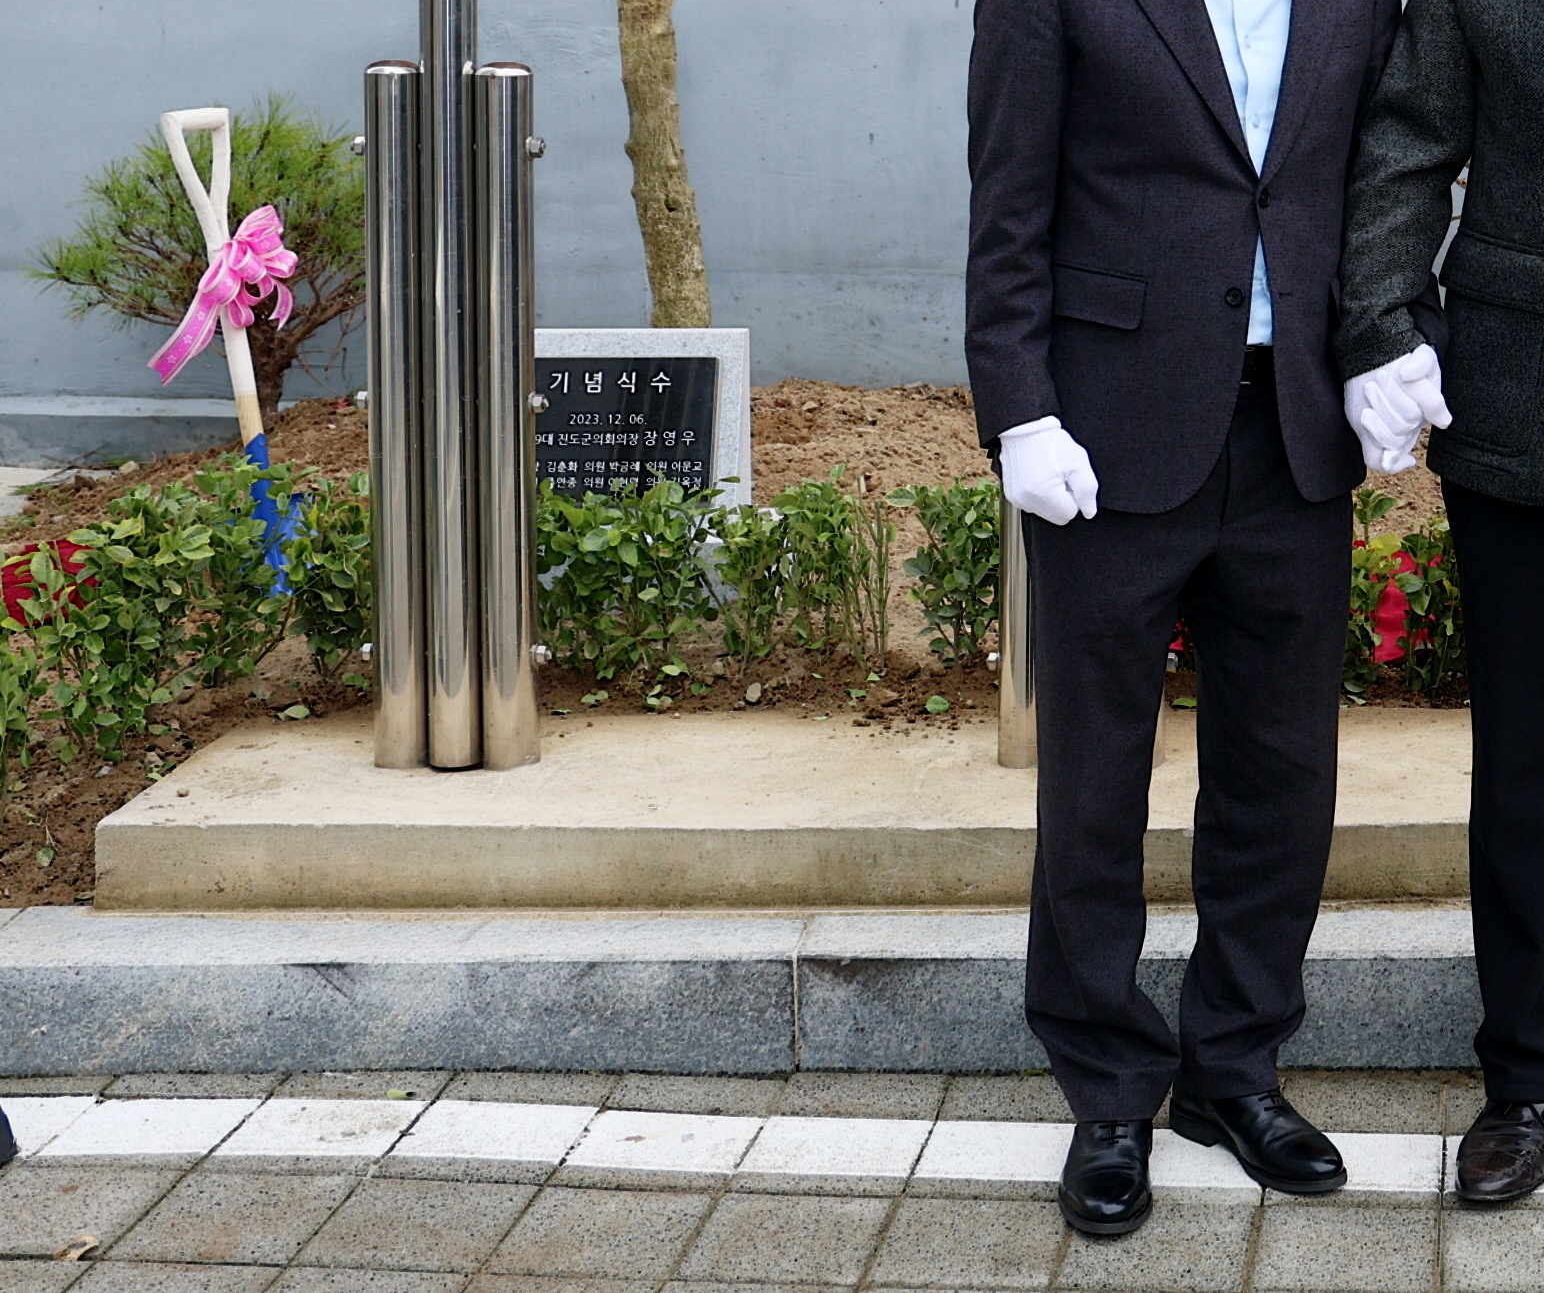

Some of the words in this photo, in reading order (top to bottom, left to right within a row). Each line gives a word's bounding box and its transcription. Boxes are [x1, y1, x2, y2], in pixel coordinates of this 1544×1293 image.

[569, 414, 603, 425] 2023.
[608, 414, 625, 425] 12.
[629, 414, 648, 425] 06.
[557, 433, 640, 446] 진도군의회의장
[584, 461, 606, 473] 의원
[583, 477, 605, 489] 의원
